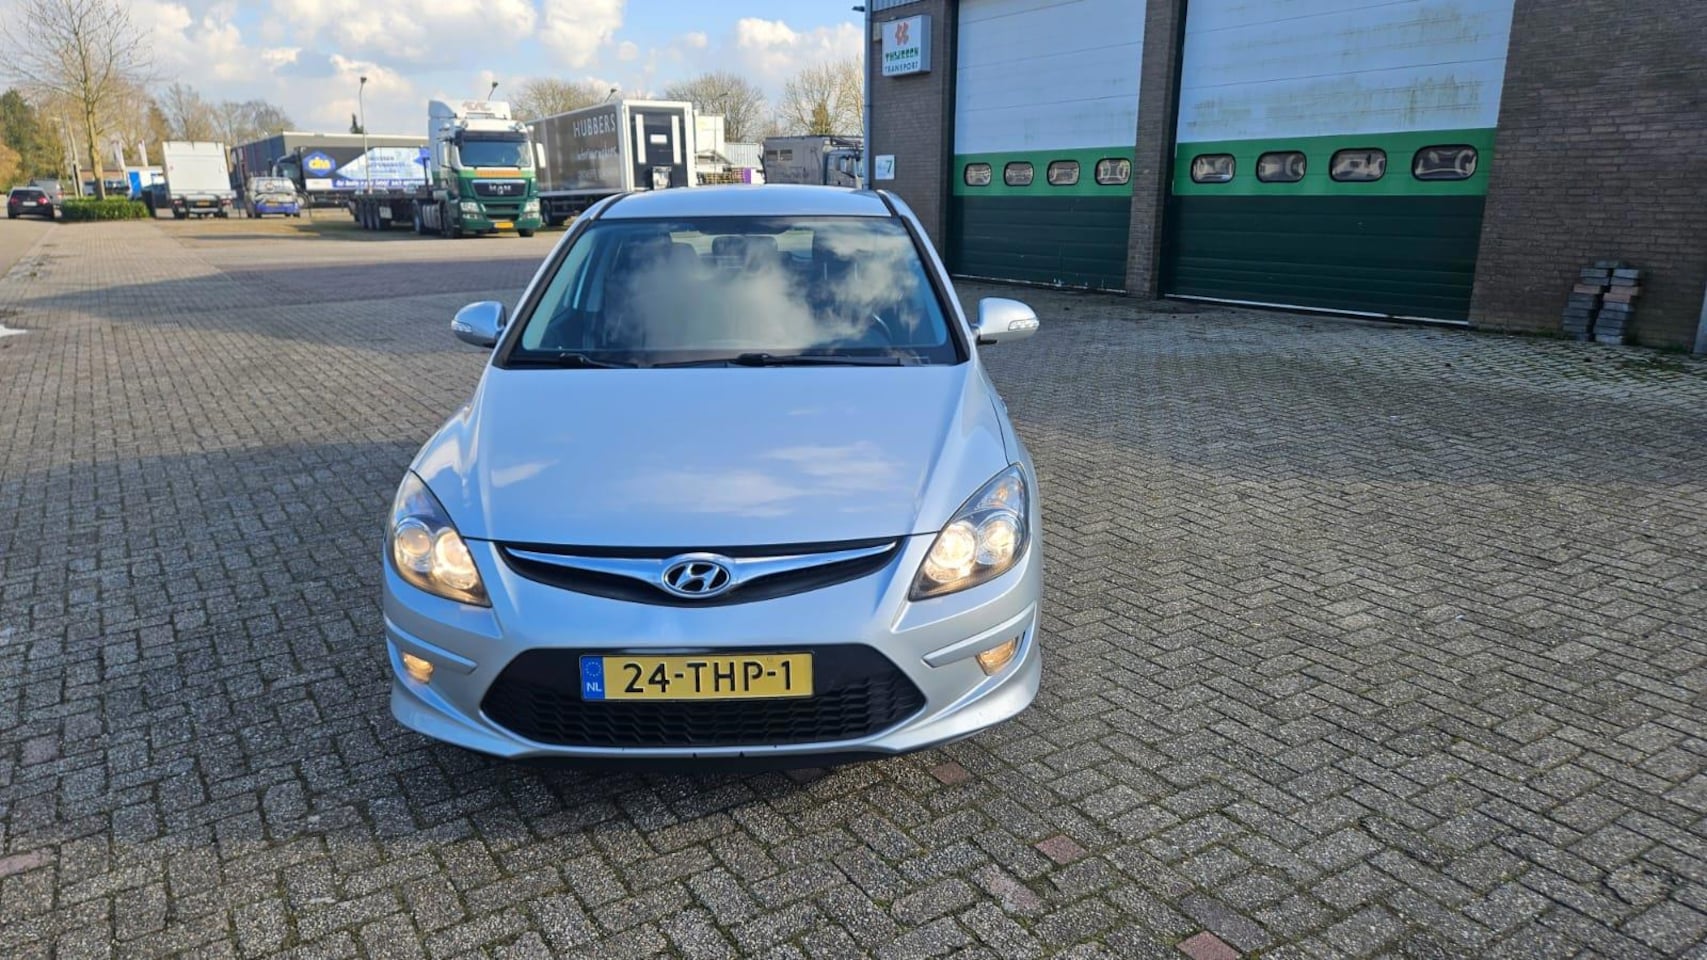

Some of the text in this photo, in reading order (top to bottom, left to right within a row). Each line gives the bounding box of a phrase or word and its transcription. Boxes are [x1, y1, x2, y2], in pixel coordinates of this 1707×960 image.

[572, 112, 616, 139] HUBBERS
[586, 682, 603, 692] NL
[623, 660, 791, 693] 24-THP-1
